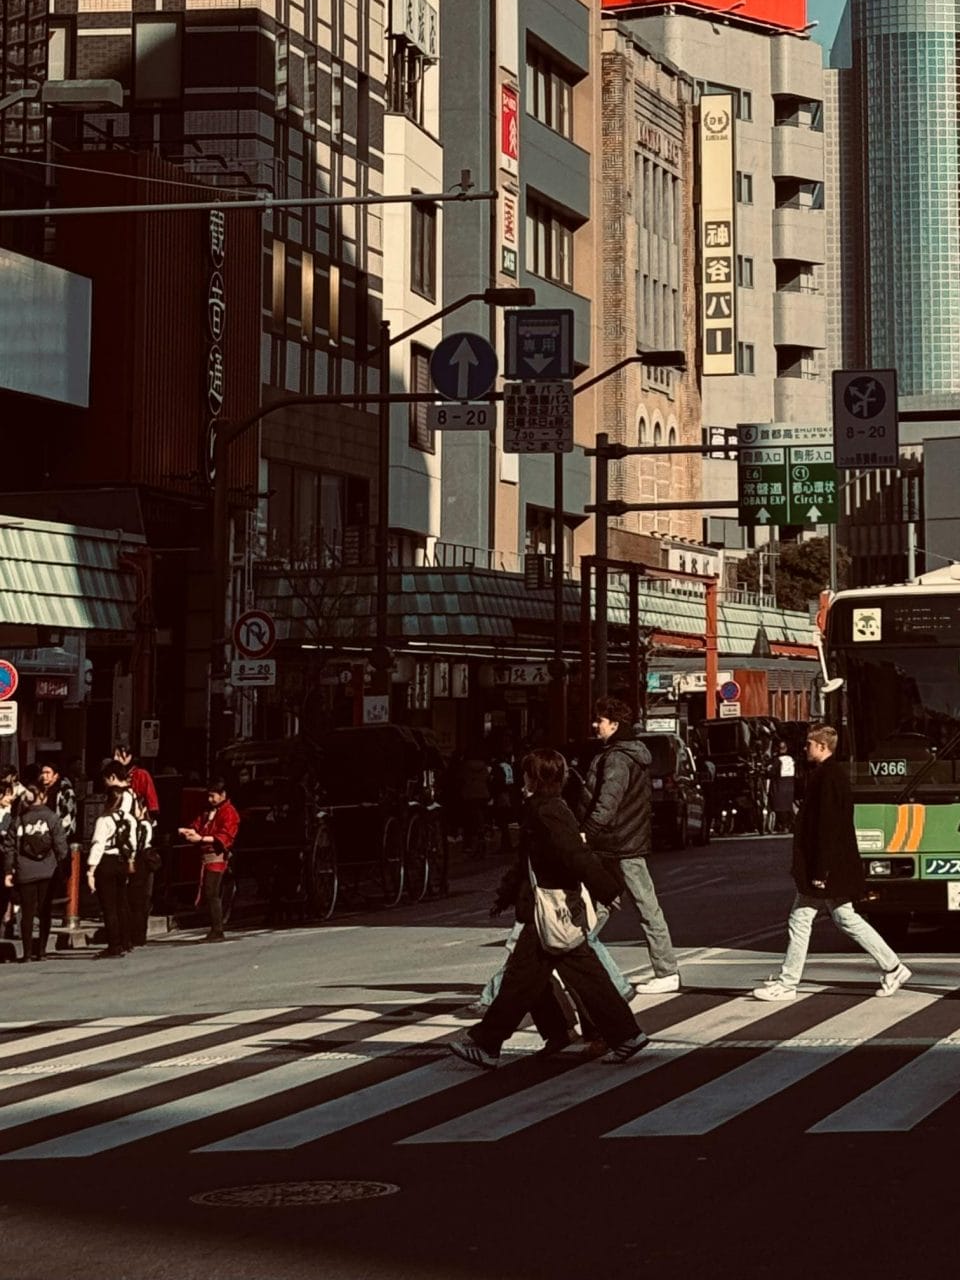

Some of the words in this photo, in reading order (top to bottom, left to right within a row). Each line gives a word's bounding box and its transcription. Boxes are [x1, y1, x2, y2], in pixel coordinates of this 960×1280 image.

[706, 223, 731, 352] 神谷バー
[744, 428, 753, 439] 6
[511, 441, 565, 451] ここまで
[794, 494, 824, 504] Circle
[827, 494, 834, 504] 1
[870, 761, 905, 776] V366
